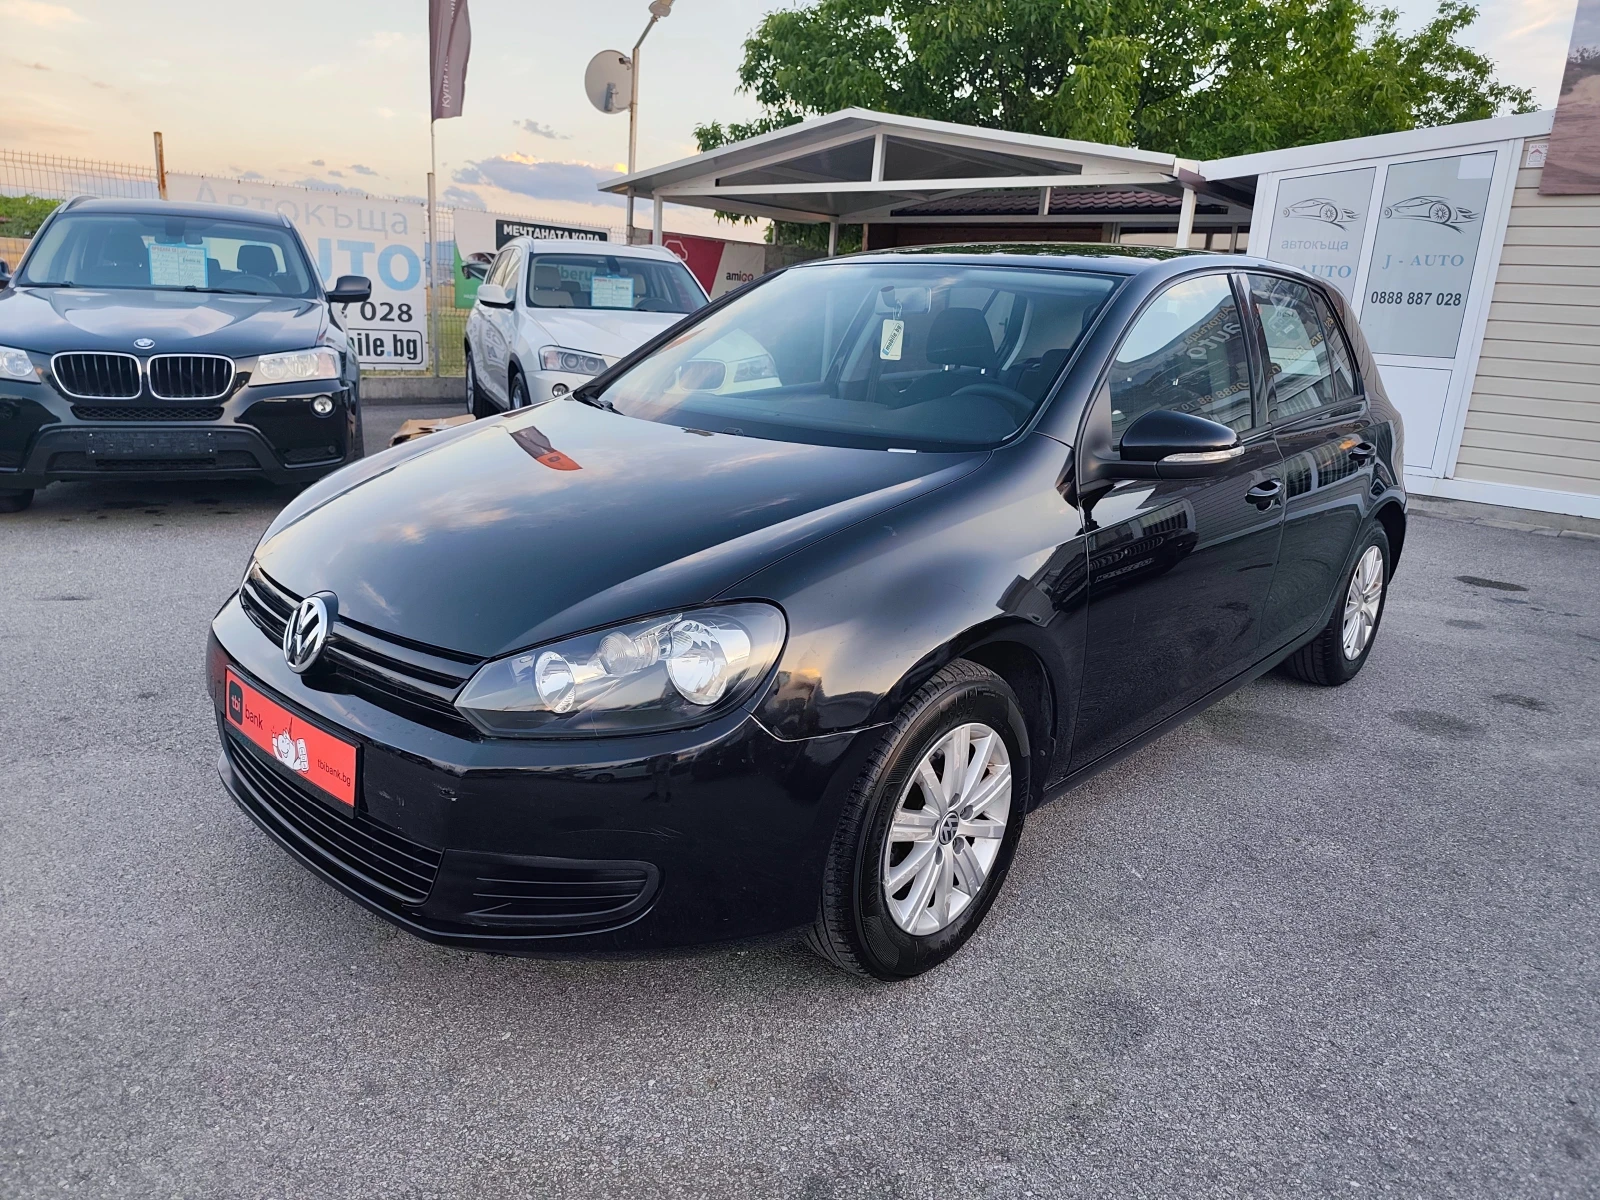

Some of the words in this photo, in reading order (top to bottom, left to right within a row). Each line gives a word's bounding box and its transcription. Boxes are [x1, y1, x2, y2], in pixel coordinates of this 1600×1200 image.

[502, 223, 571, 240] МЕЧТАНАТА
[1281, 240, 1348, 252] автокъща
[1382, 255, 1392, 270] J
[1410, 254, 1465, 267] AUTO
[1370, 291, 1403, 304] 0888
[1407, 292, 1432, 305] 887
[1436, 293, 1462, 306] 028
[360, 301, 413, 323] 028
[231, 694, 241, 713] tbi
[245, 704, 264, 730] bank
[317, 759, 351, 787] tbibank.bg
